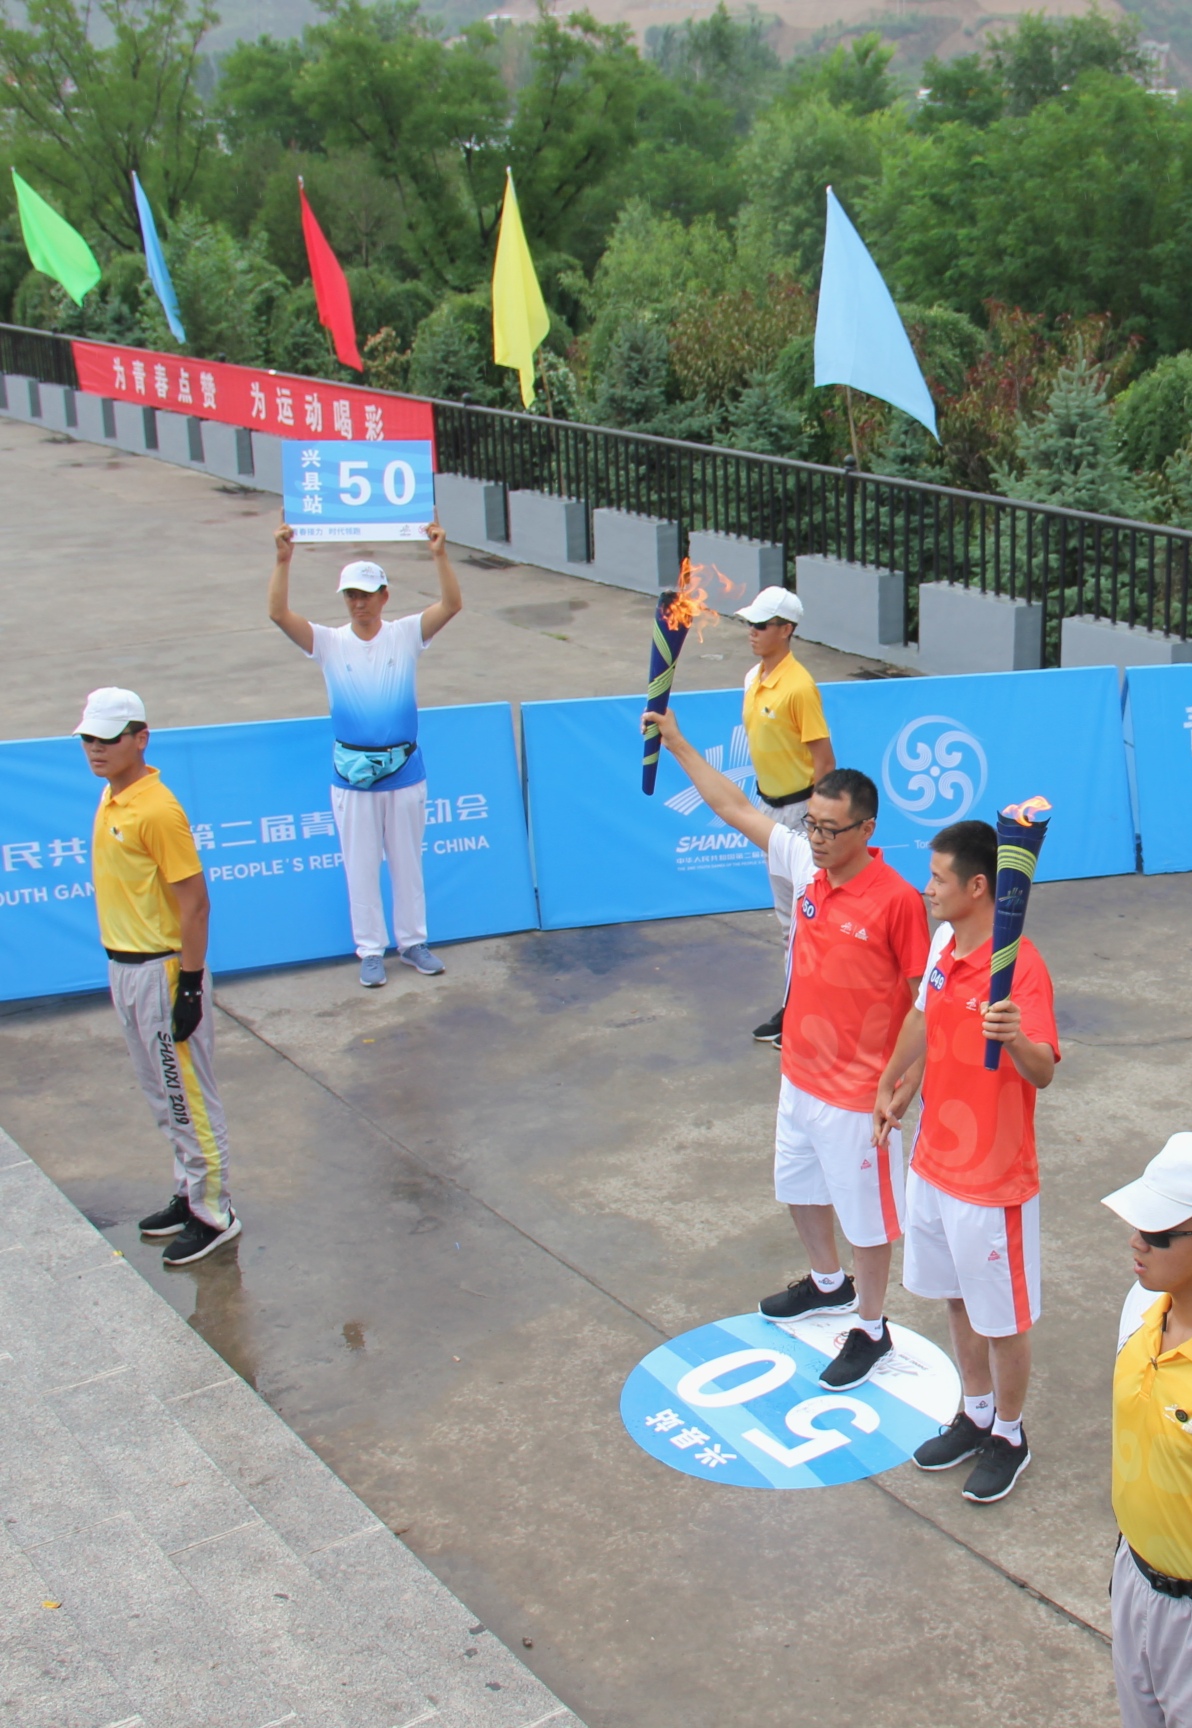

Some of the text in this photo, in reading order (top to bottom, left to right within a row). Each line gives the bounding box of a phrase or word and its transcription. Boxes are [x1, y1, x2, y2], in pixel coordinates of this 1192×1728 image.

[112, 356, 386, 442] 为青春点赞 为运动喝彩
[301, 449, 323, 515] 兴县站
[338, 460, 417, 507] 50
[433, 835, 490, 855] CHINA
[930, 969, 946, 991] 049
[156, 1030, 190, 1126] SHANXI 2019
[676, 1347, 881, 1469] 50
